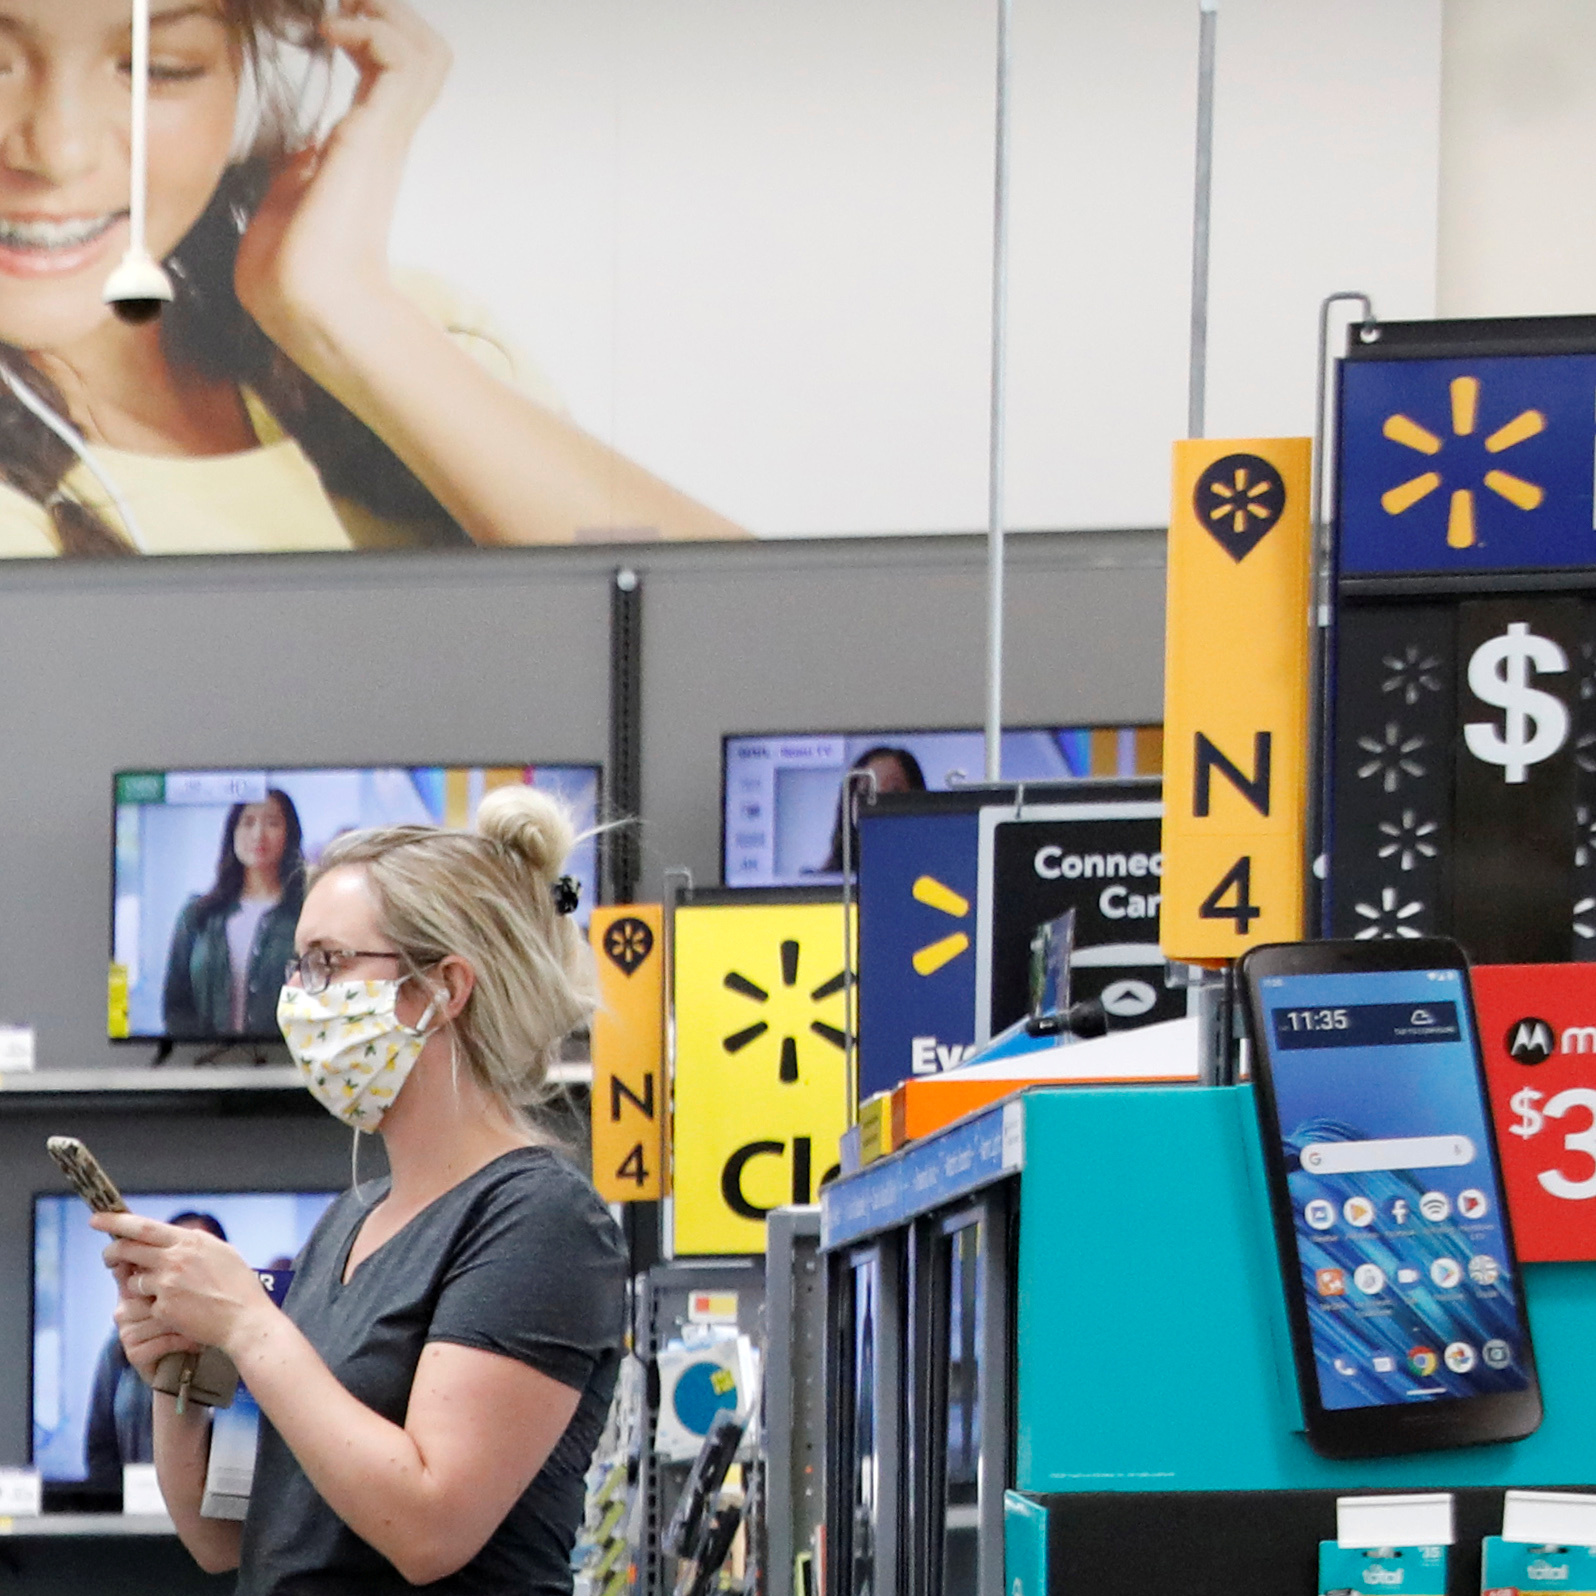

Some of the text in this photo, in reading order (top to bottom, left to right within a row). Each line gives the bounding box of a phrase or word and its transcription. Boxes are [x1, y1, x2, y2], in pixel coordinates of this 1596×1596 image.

[1464, 622, 1570, 783] $
[1192, 731, 1272, 818] N
[1199, 856, 1261, 935] 4
[1287, 1010, 1350, 1031] 11:35
[611, 1073, 654, 1122] N
[615, 1143, 650, 1188] 4
[721, 1137, 842, 1222] Cl
